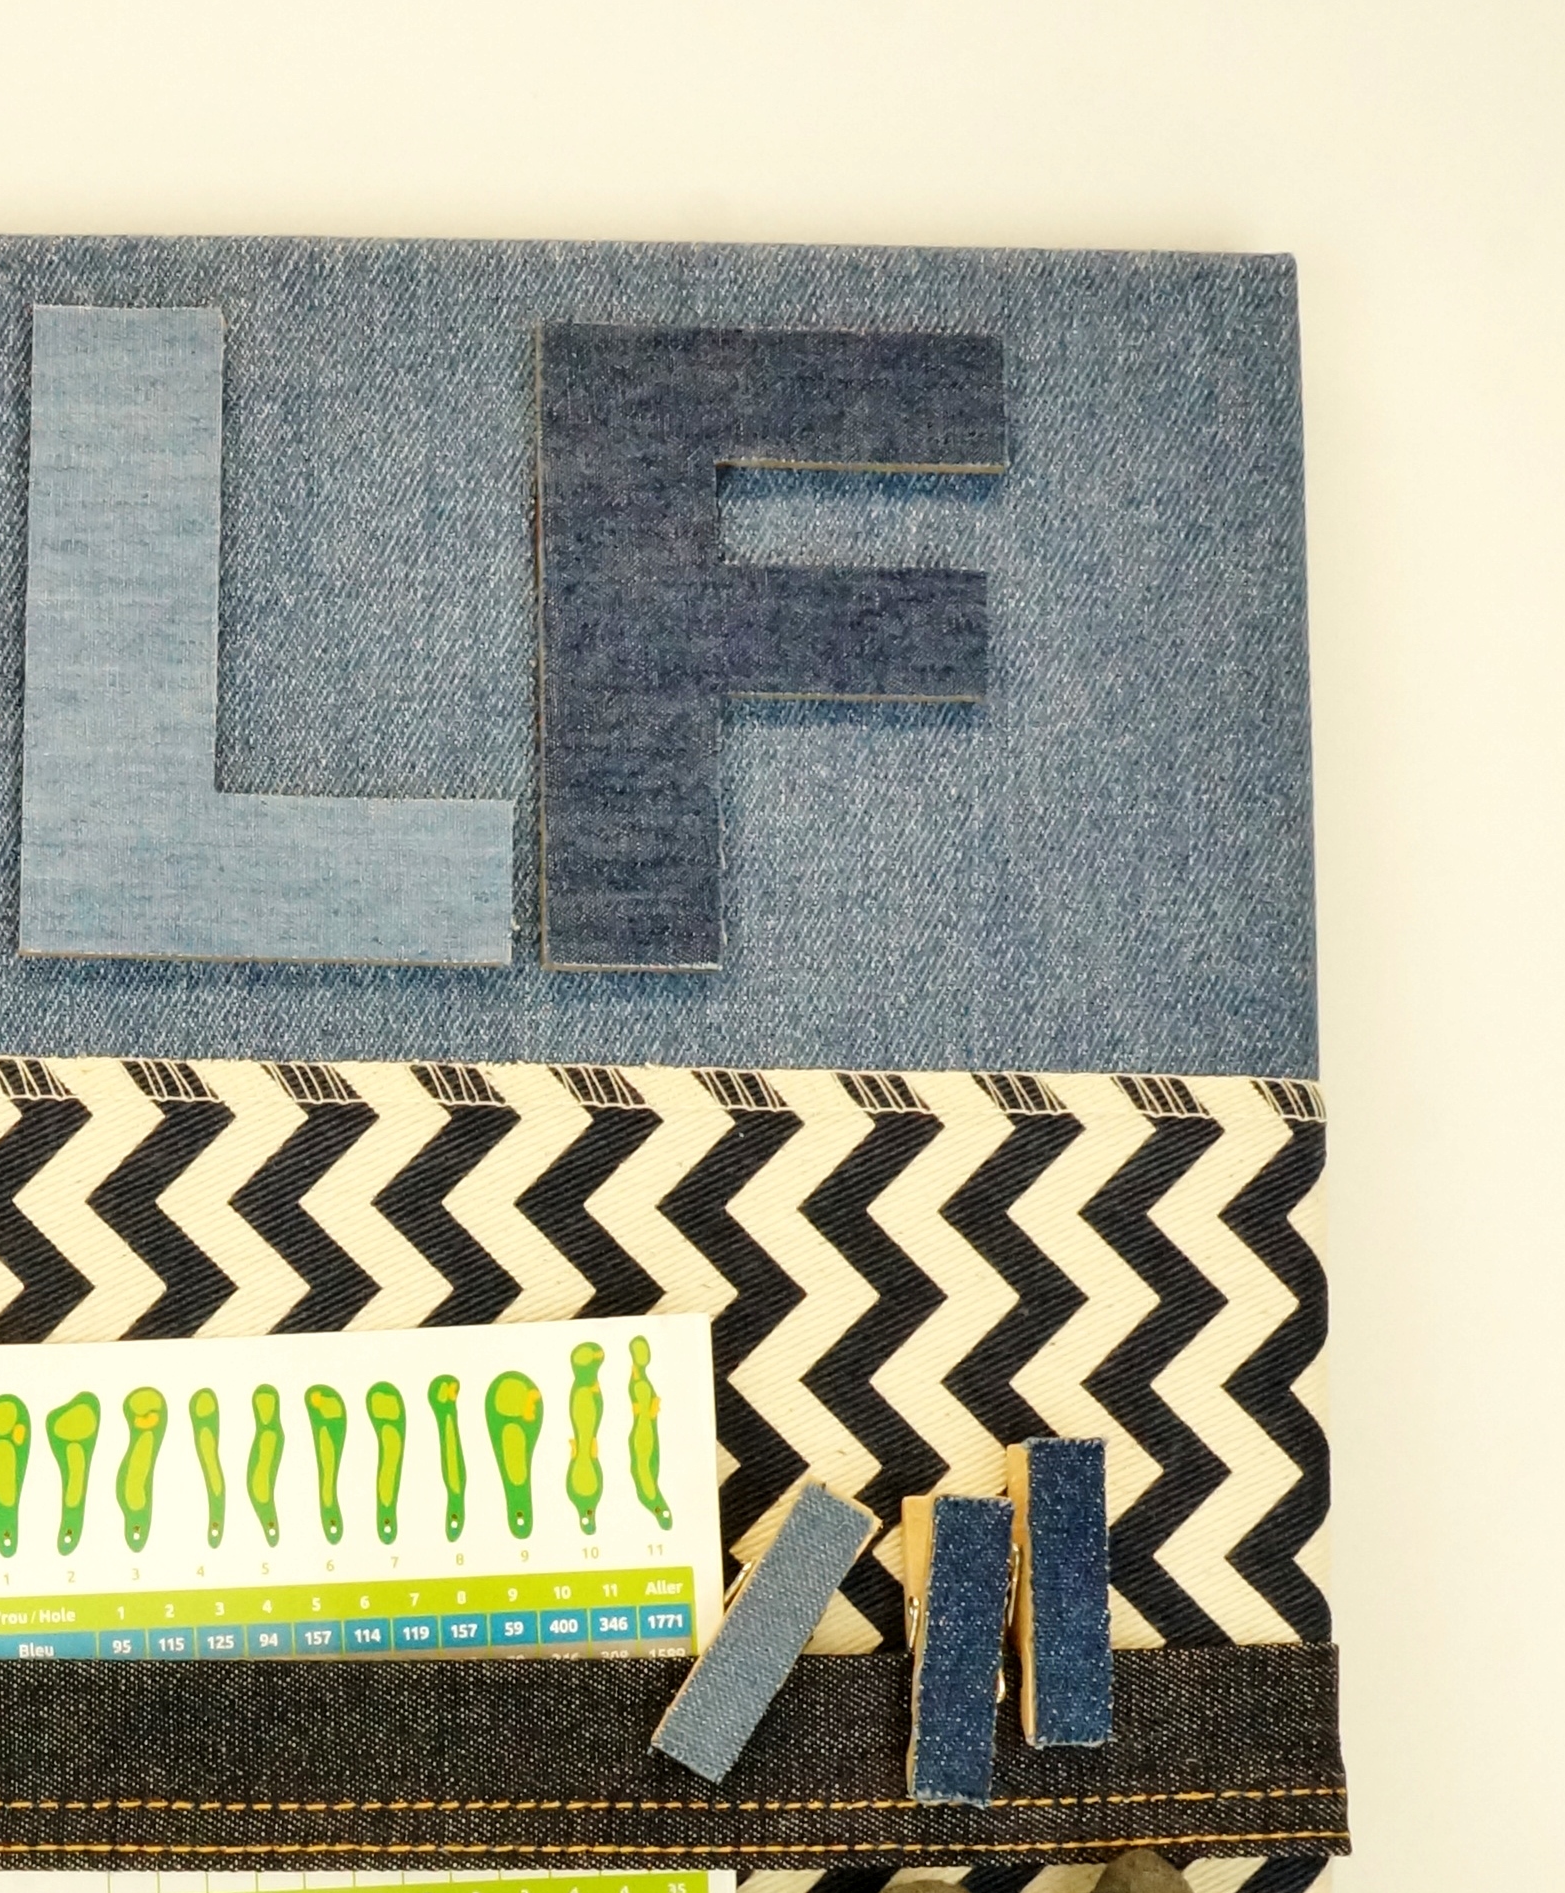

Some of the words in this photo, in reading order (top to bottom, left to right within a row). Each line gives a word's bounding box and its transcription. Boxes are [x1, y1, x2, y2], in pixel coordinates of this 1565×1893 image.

[4, 1574, 10, 1586] 1
[68, 1570, 76, 1584] 2
[132, 1568, 140, 1580] 3
[196, 1566, 204, 1578] 4
[262, 1562, 270, 1576] 5
[326, 1560, 334, 1572] 6
[390, 1556, 398, 1570] 7
[456, 1554, 464, 1566] 8
[520, 1550, 530, 1562] 9
[582, 1546, 600, 1560] 10
[648, 1544, 664, 1556] 11
[38, 1608, 76, 1624] Hole
[116, 1606, 126, 1620] 1
[165, 1604, 175, 1618] 2
[214, 1602, 225, 1616] 3
[262, 1600, 272, 1614] 4
[312, 1598, 322, 1612] 5
[360, 1596, 370, 1608] 6
[410, 1592, 420, 1606] 7
[456, 1591, 466, 1604] 8
[508, 1588, 518, 1602] 9
[554, 1586, 572, 1600] 10
[602, 1584, 618, 1598] 11
[646, 1580, 683, 1596] Aller
[18, 1642, 54, 1658] Bleu
[112, 1640, 132, 1654] 95
[158, 1638, 184, 1652] 115
[207, 1635, 234, 1650] 125
[258, 1634, 278, 1648] 94
[304, 1630, 332, 1646] 157
[354, 1628, 382, 1644] 114
[402, 1626, 430, 1642] 119
[450, 1624, 478, 1639] 157
[504, 1620, 524, 1636] 59
[550, 1618, 578, 1634] 400
[599, 1616, 628, 1632] 346
[646, 1614, 684, 1630] 1771
